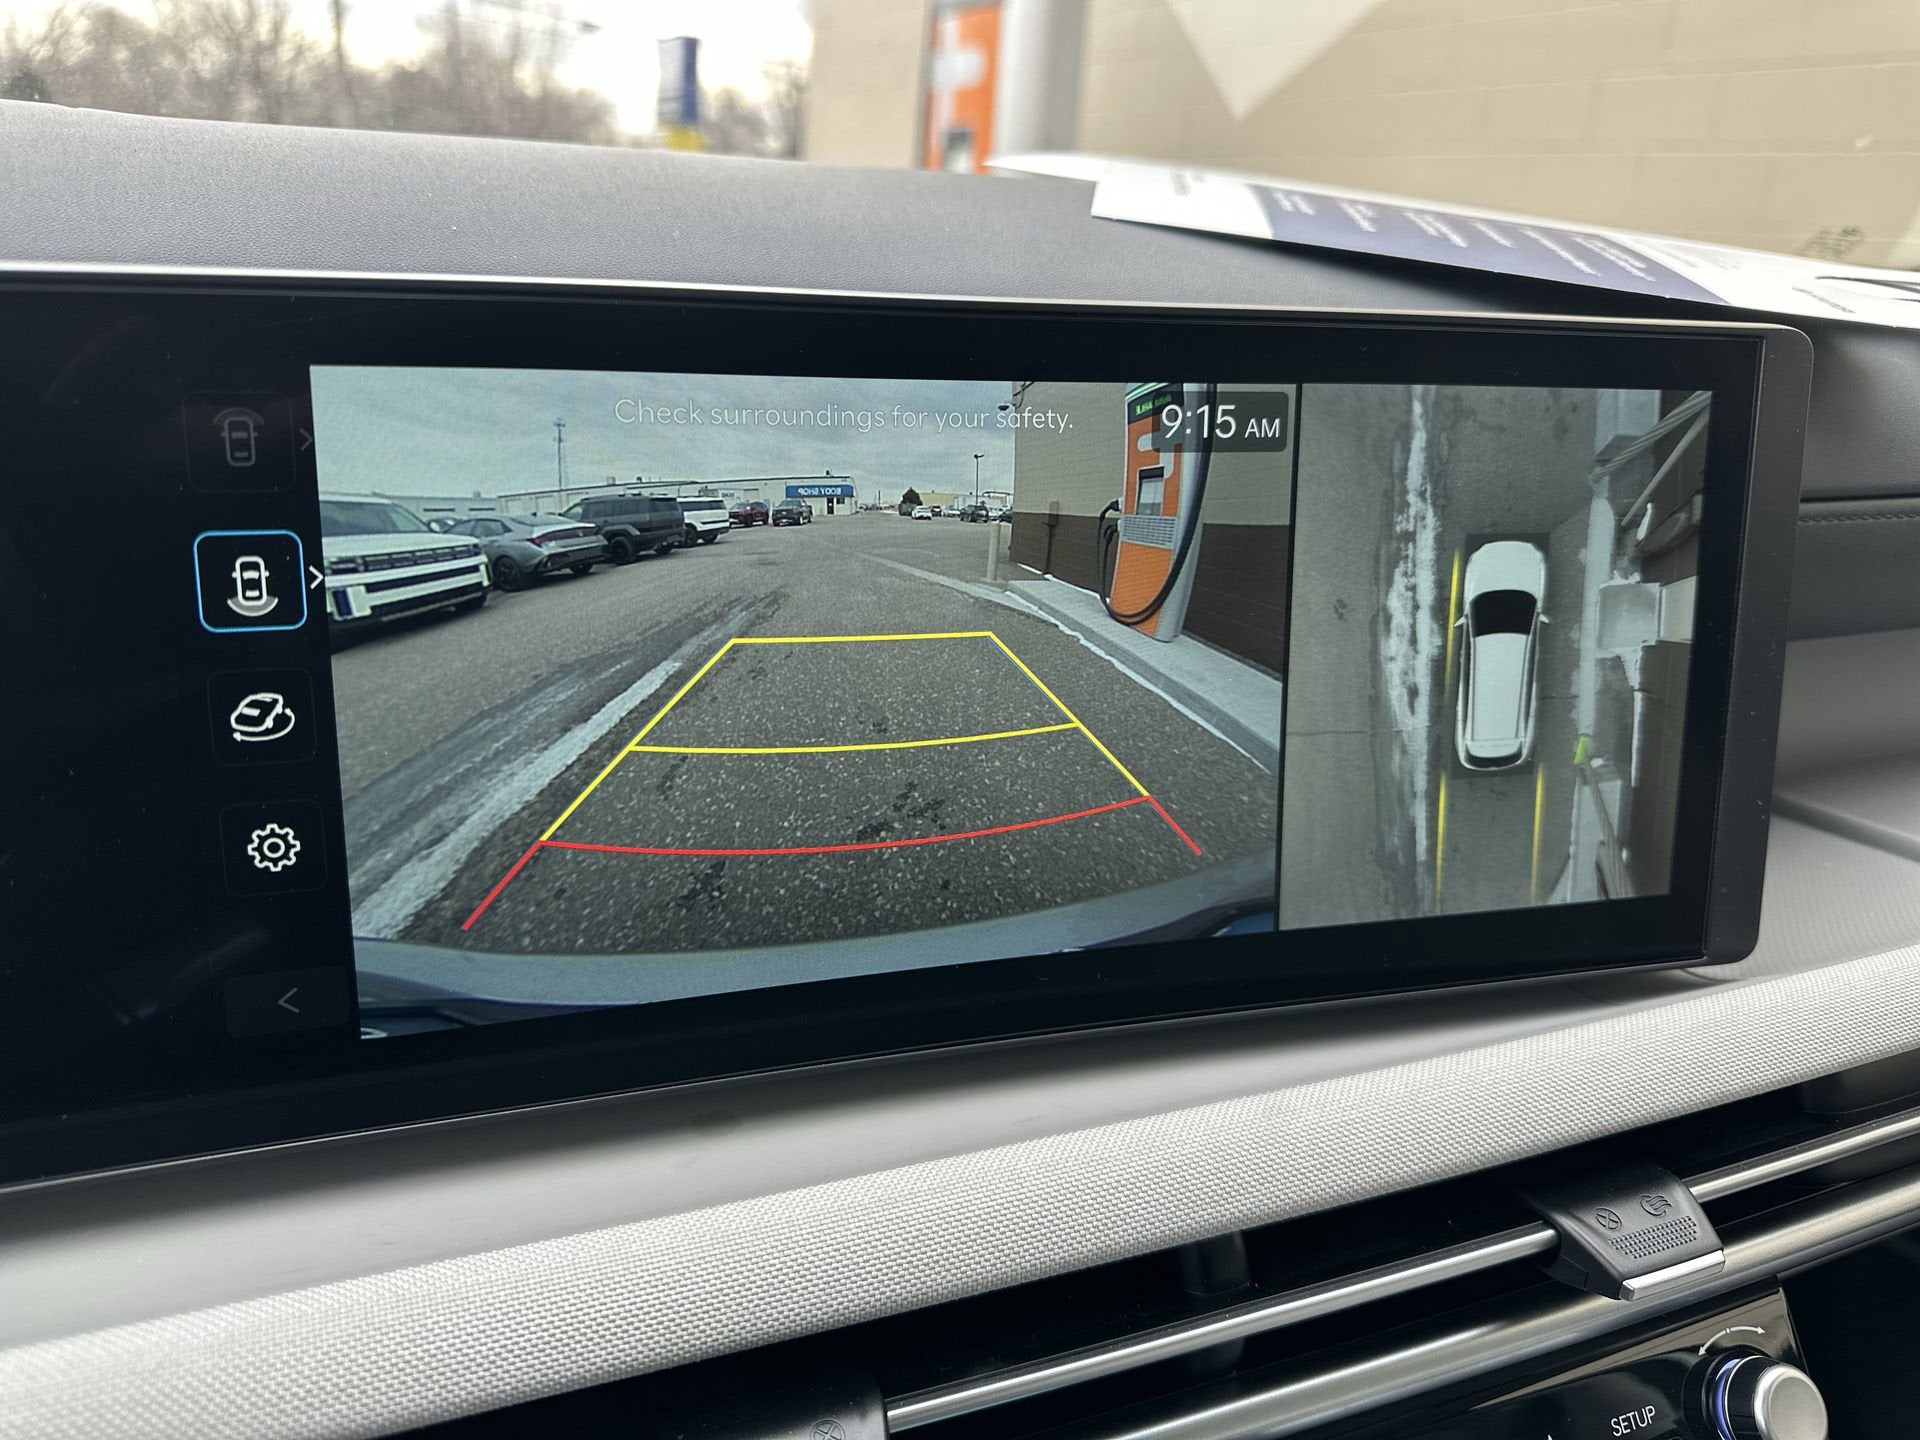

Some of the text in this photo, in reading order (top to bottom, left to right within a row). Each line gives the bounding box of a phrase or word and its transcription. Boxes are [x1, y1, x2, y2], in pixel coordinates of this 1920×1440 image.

[614, 398, 1074, 434] Check surroundings for your safety.
[1161, 404, 1237, 439] 9:15
[1244, 417, 1281, 439] AM
[1610, 1405, 1656, 1437] SETUP
